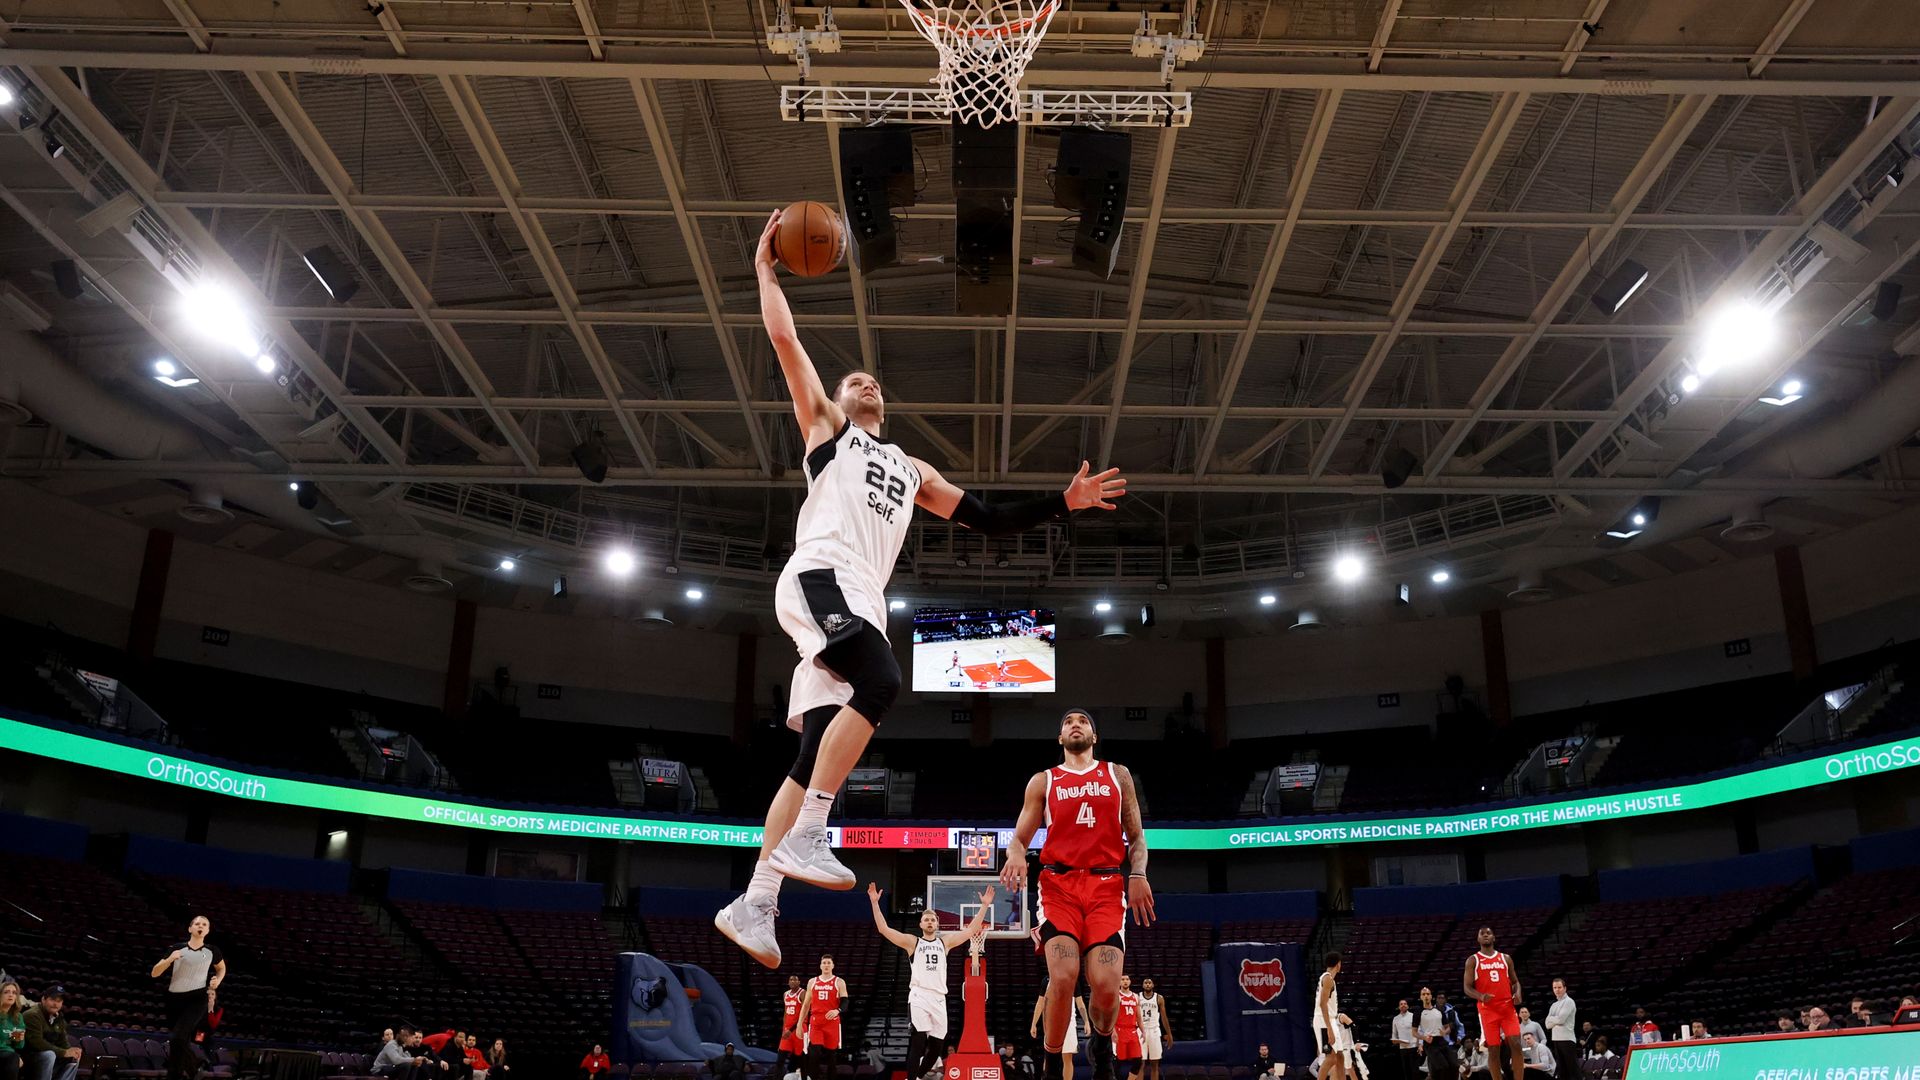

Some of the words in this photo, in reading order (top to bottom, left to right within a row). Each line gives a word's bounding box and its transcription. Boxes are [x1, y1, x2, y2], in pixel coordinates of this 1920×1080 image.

[866, 461, 906, 508] 22
[867, 491, 895, 524] Self.
[1825, 745, 1920, 778] OrthoSo
[147, 757, 266, 799] OrthoSouth
[643, 767, 678, 777] ULTRA
[1056, 781, 1111, 801] hustle
[423, 805, 486, 826] OFFICIAL
[489, 814, 544, 830] SPORTS
[548, 819, 620, 835] MEDICINE
[624, 824, 687, 840] PARTNER
[691, 828, 719, 841] FOR
[722, 830, 748, 843] THE
[1075, 802, 1096, 828] 4
[1229, 831, 1291, 845] OFFICIAL
[1294, 827, 1347, 842] SPORTS
[1350, 823, 1421, 839] MEDICINE
[1425, 818, 1488, 834] PARTNER
[1491, 814, 1520, 829] FOR
[1522, 809, 1550, 826] THE
[1553, 801, 1622, 821] MEMPHIS
[1624, 793, 1682, 812] HUSTLE
[846, 830, 883, 845] HUSTLE
[966, 848, 990, 867] 22
[926, 954, 938, 964] 19
[1480, 962, 1505, 970] hustle
[1243, 973, 1282, 987] hustle
[1490, 970, 1500, 982] 9
[818, 991, 829, 1000] 51
[1142, 1010, 1152, 1018] 14
[1640, 1048, 1720, 1073] OrthoSouth
[974, 1070, 998, 1078] BRS
